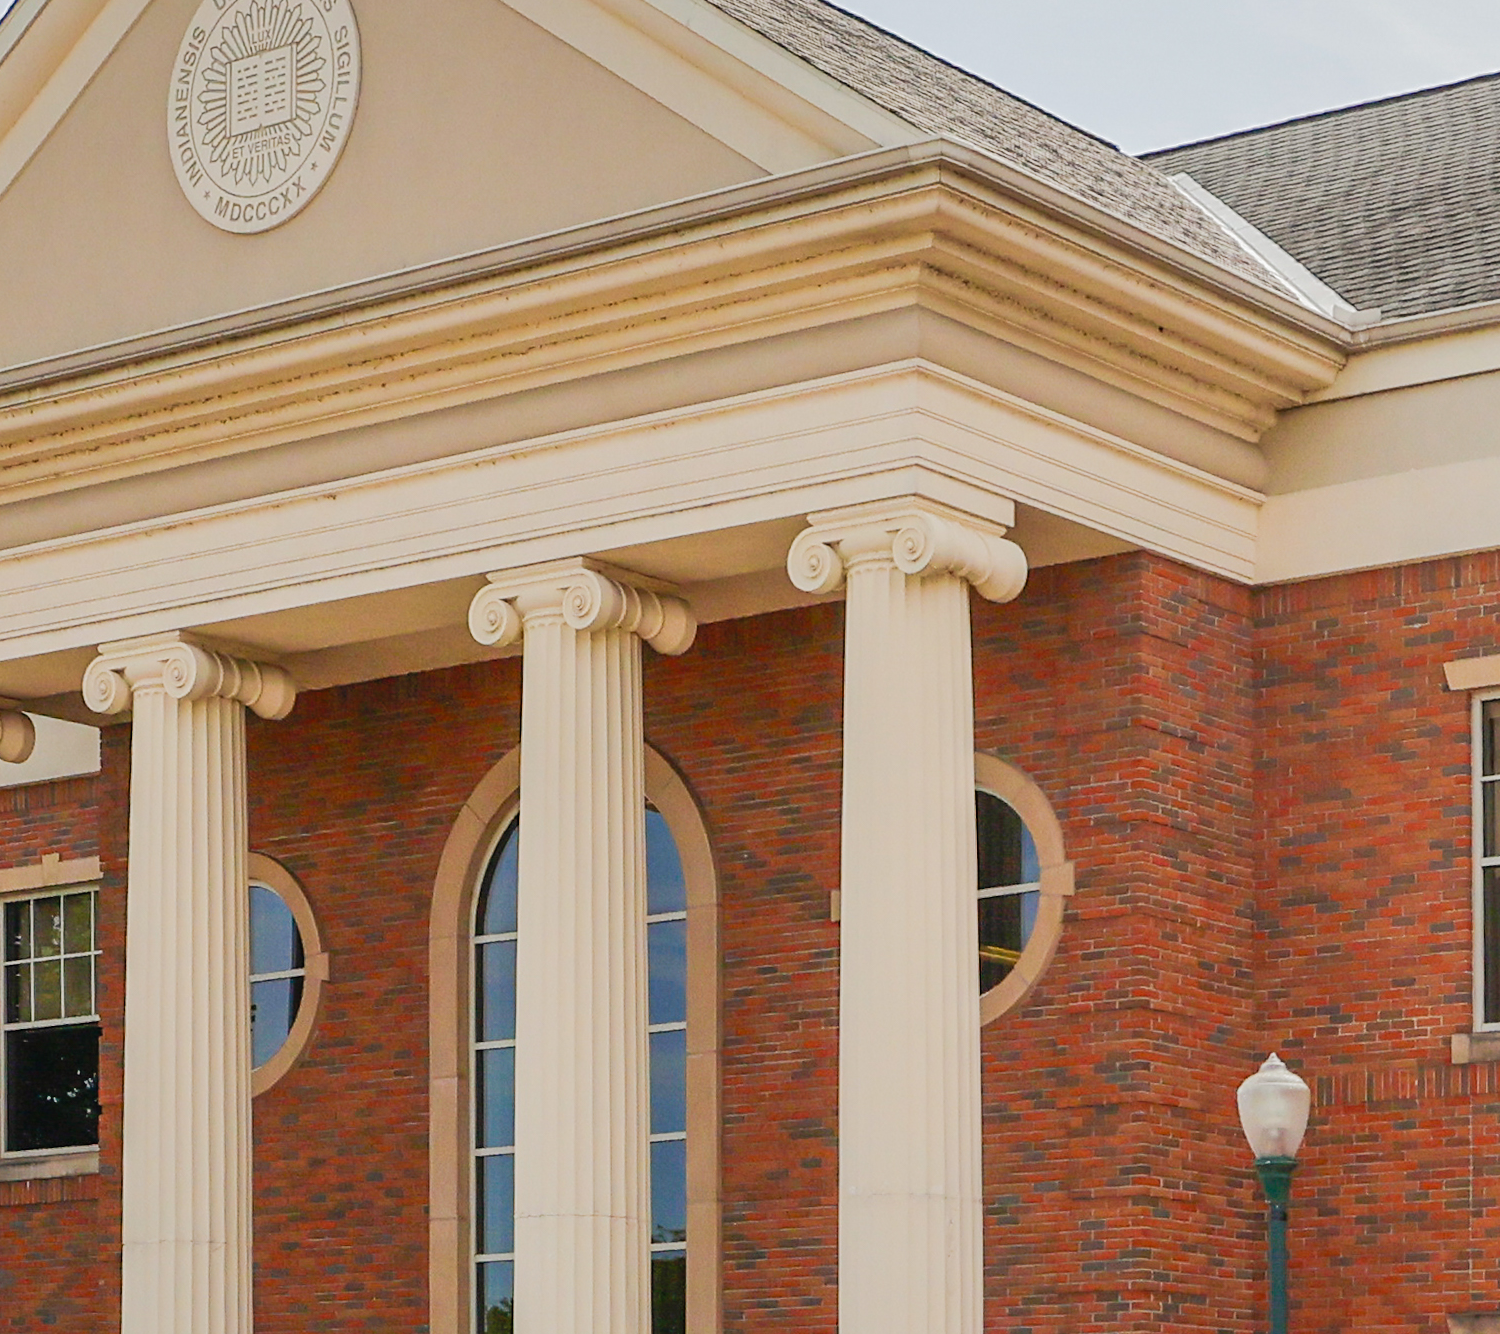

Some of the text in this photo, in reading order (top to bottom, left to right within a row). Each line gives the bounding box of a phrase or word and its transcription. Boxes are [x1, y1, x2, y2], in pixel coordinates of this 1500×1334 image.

[251, 28, 272, 45] LUX
[174, 25, 206, 189] INDIANENSIS
[319, 24, 352, 153] SIGILLUM
[232, 134, 292, 160] ET VERITAS
[214, 175, 307, 222] MDCCCXX
